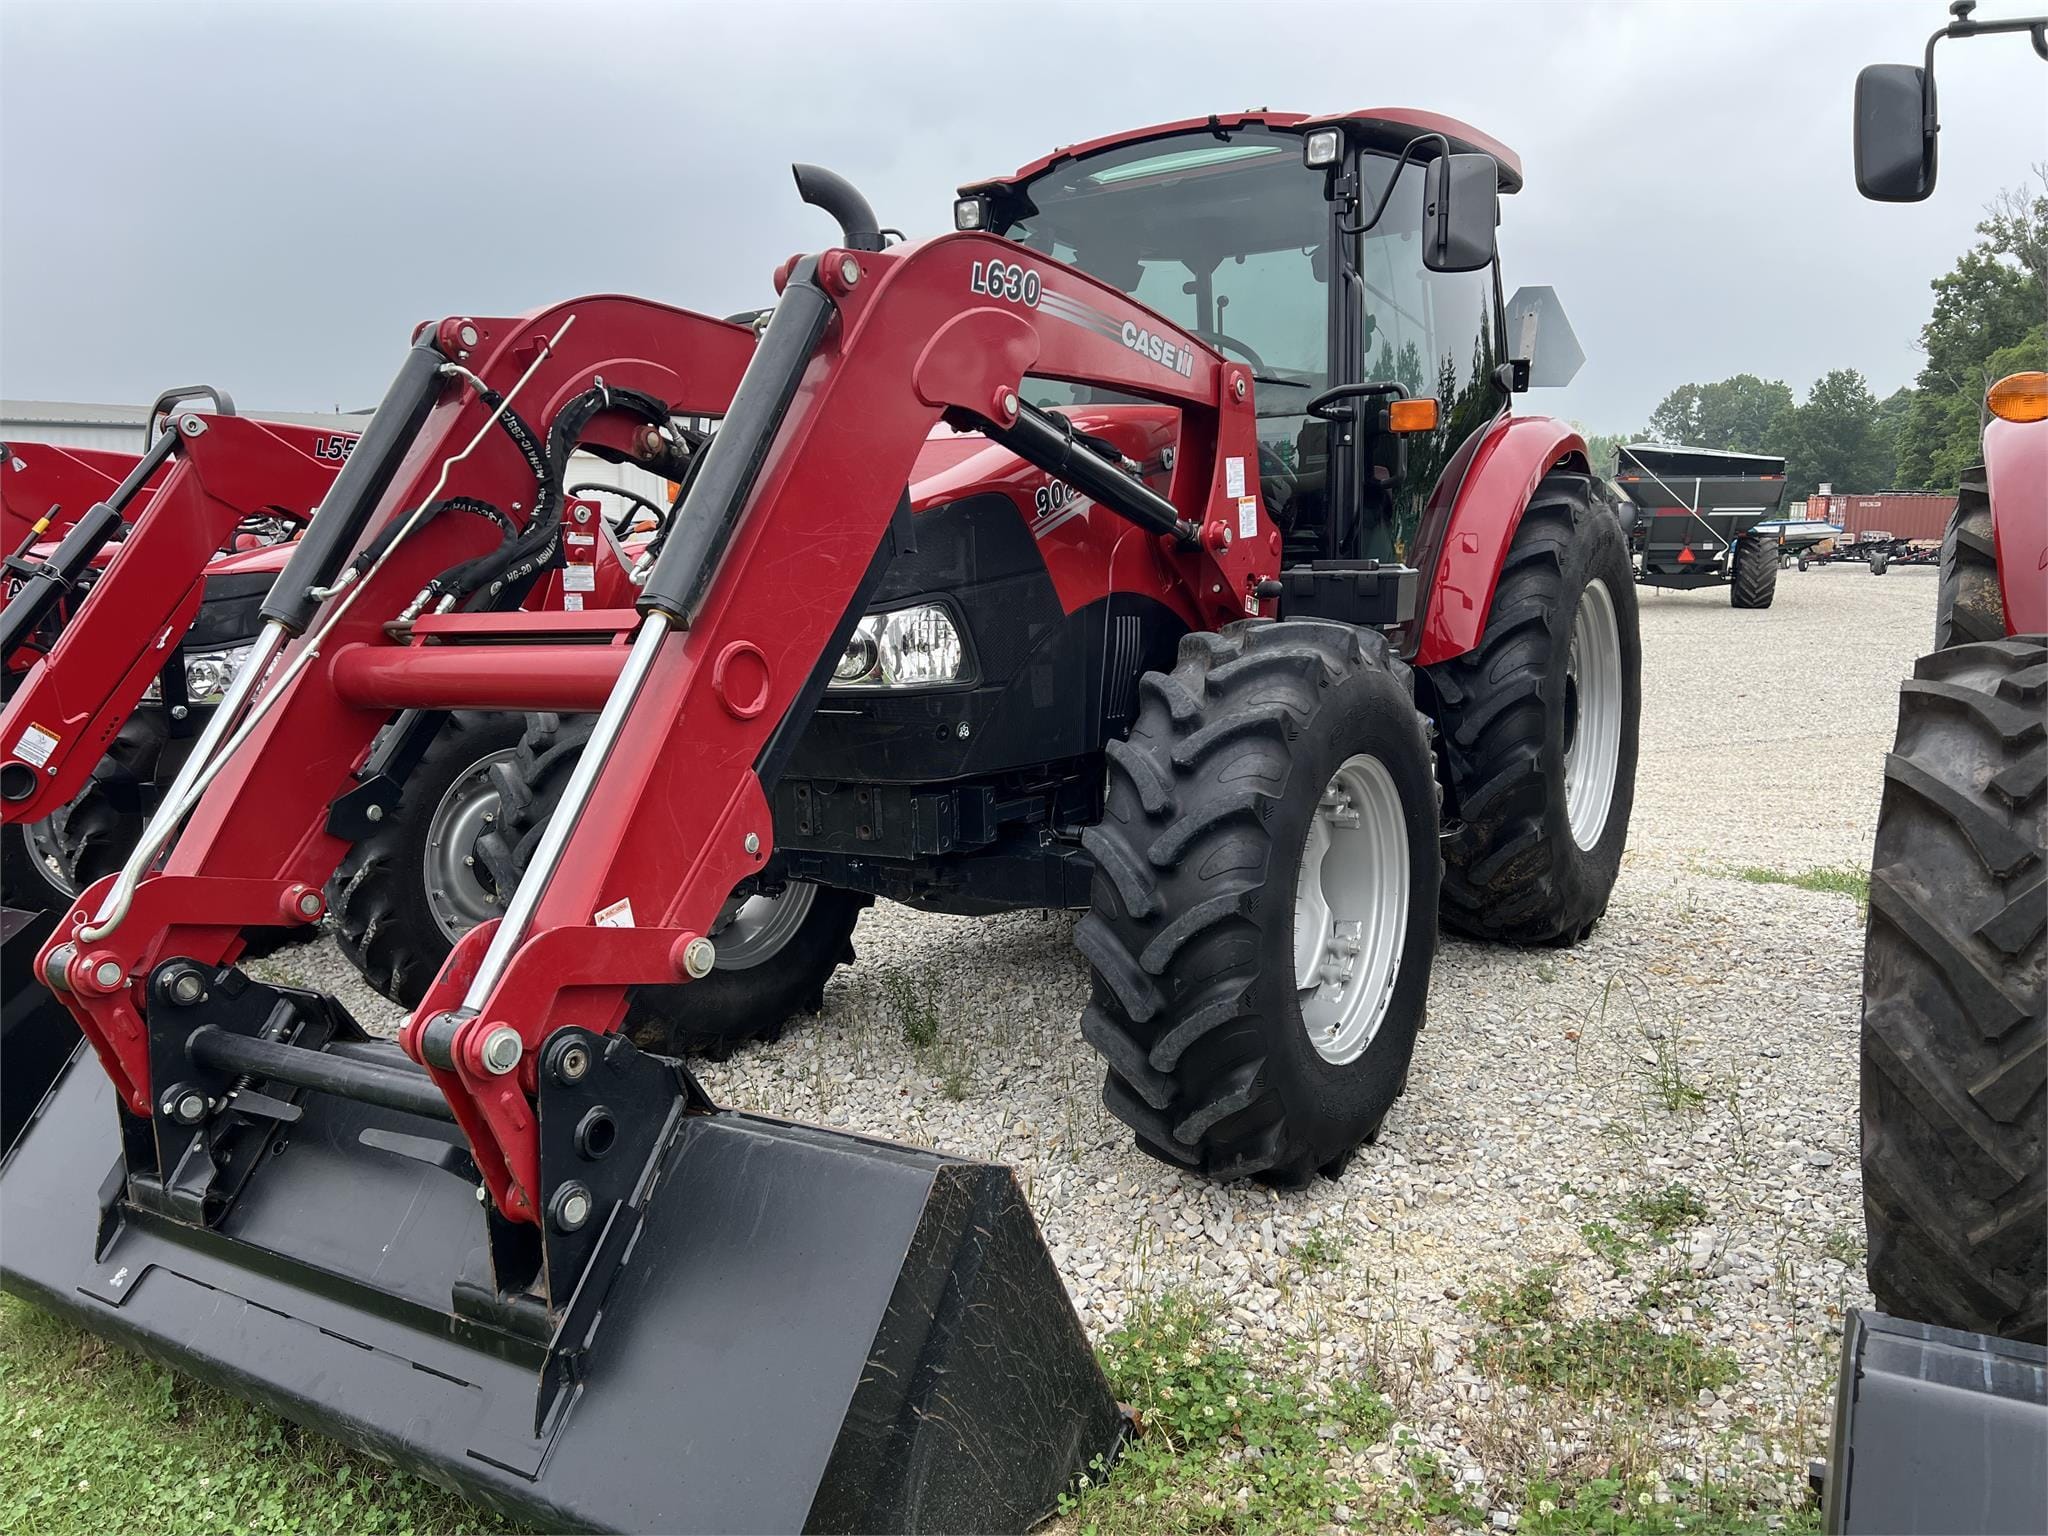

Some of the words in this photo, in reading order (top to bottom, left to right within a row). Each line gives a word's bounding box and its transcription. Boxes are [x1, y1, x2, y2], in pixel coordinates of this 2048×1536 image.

[970, 258, 1041, 308] L630
[1121, 320, 1176, 369] CASE
[506, 563, 532, 582] HG-20
